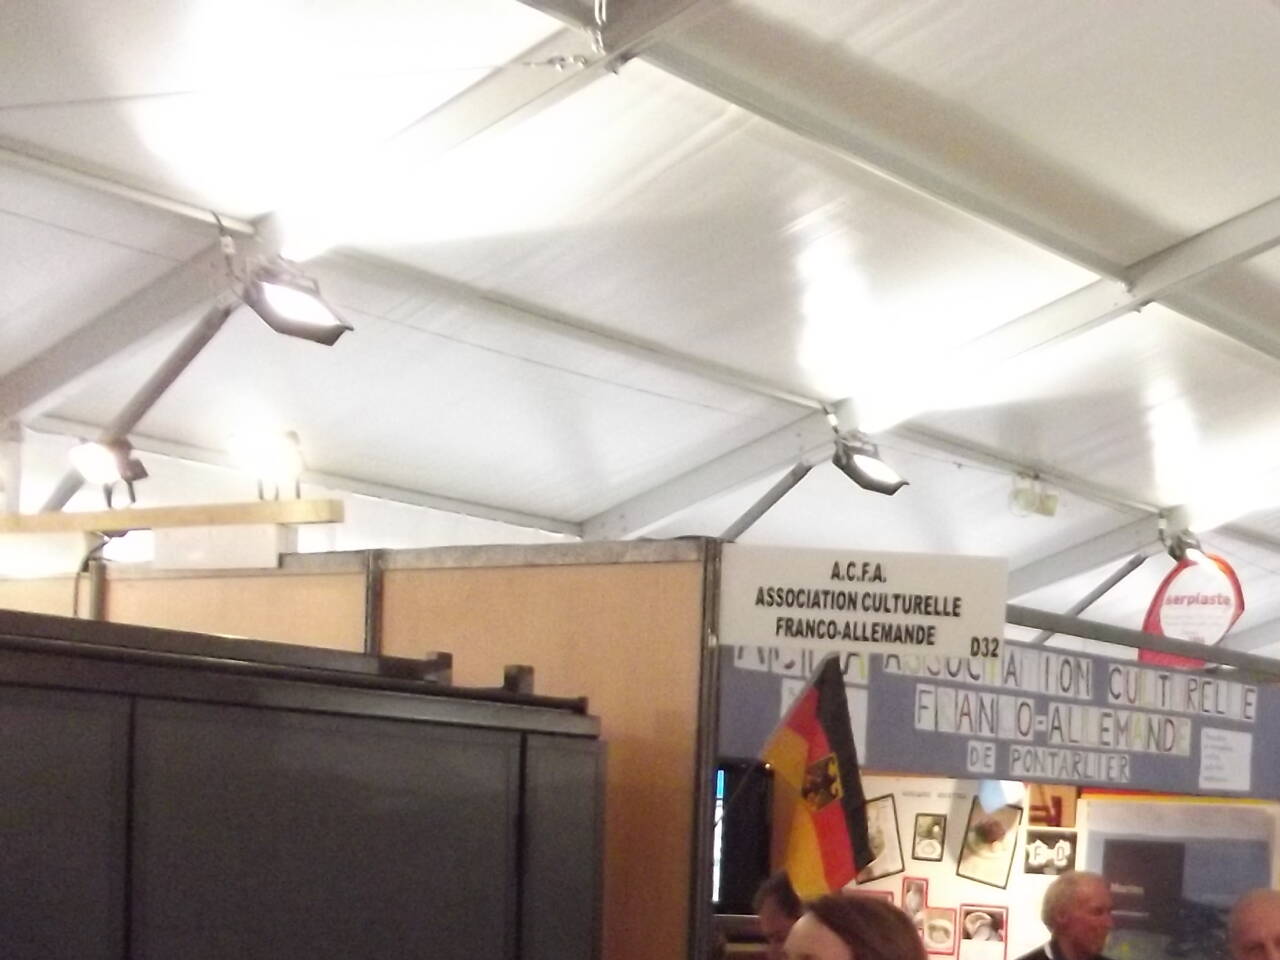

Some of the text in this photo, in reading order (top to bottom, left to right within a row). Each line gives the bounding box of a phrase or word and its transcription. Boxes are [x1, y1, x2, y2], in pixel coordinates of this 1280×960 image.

[831, 561, 887, 582] A.C.F.A.
[755, 586, 962, 617] ASSOCIATION CULTURELLE
[1165, 591, 1232, 608] serplaste
[776, 616, 937, 645] FRANCO-ALLEMANDE
[970, 636, 1000, 658] D32
[884, 649, 1091, 698] SOCIAION
[1108, 664, 1256, 721] CULTRELE
[916, 690, 1190, 752] FANO-ALEMANDE
[969, 745, 1130, 782] DE PONTARLIER
